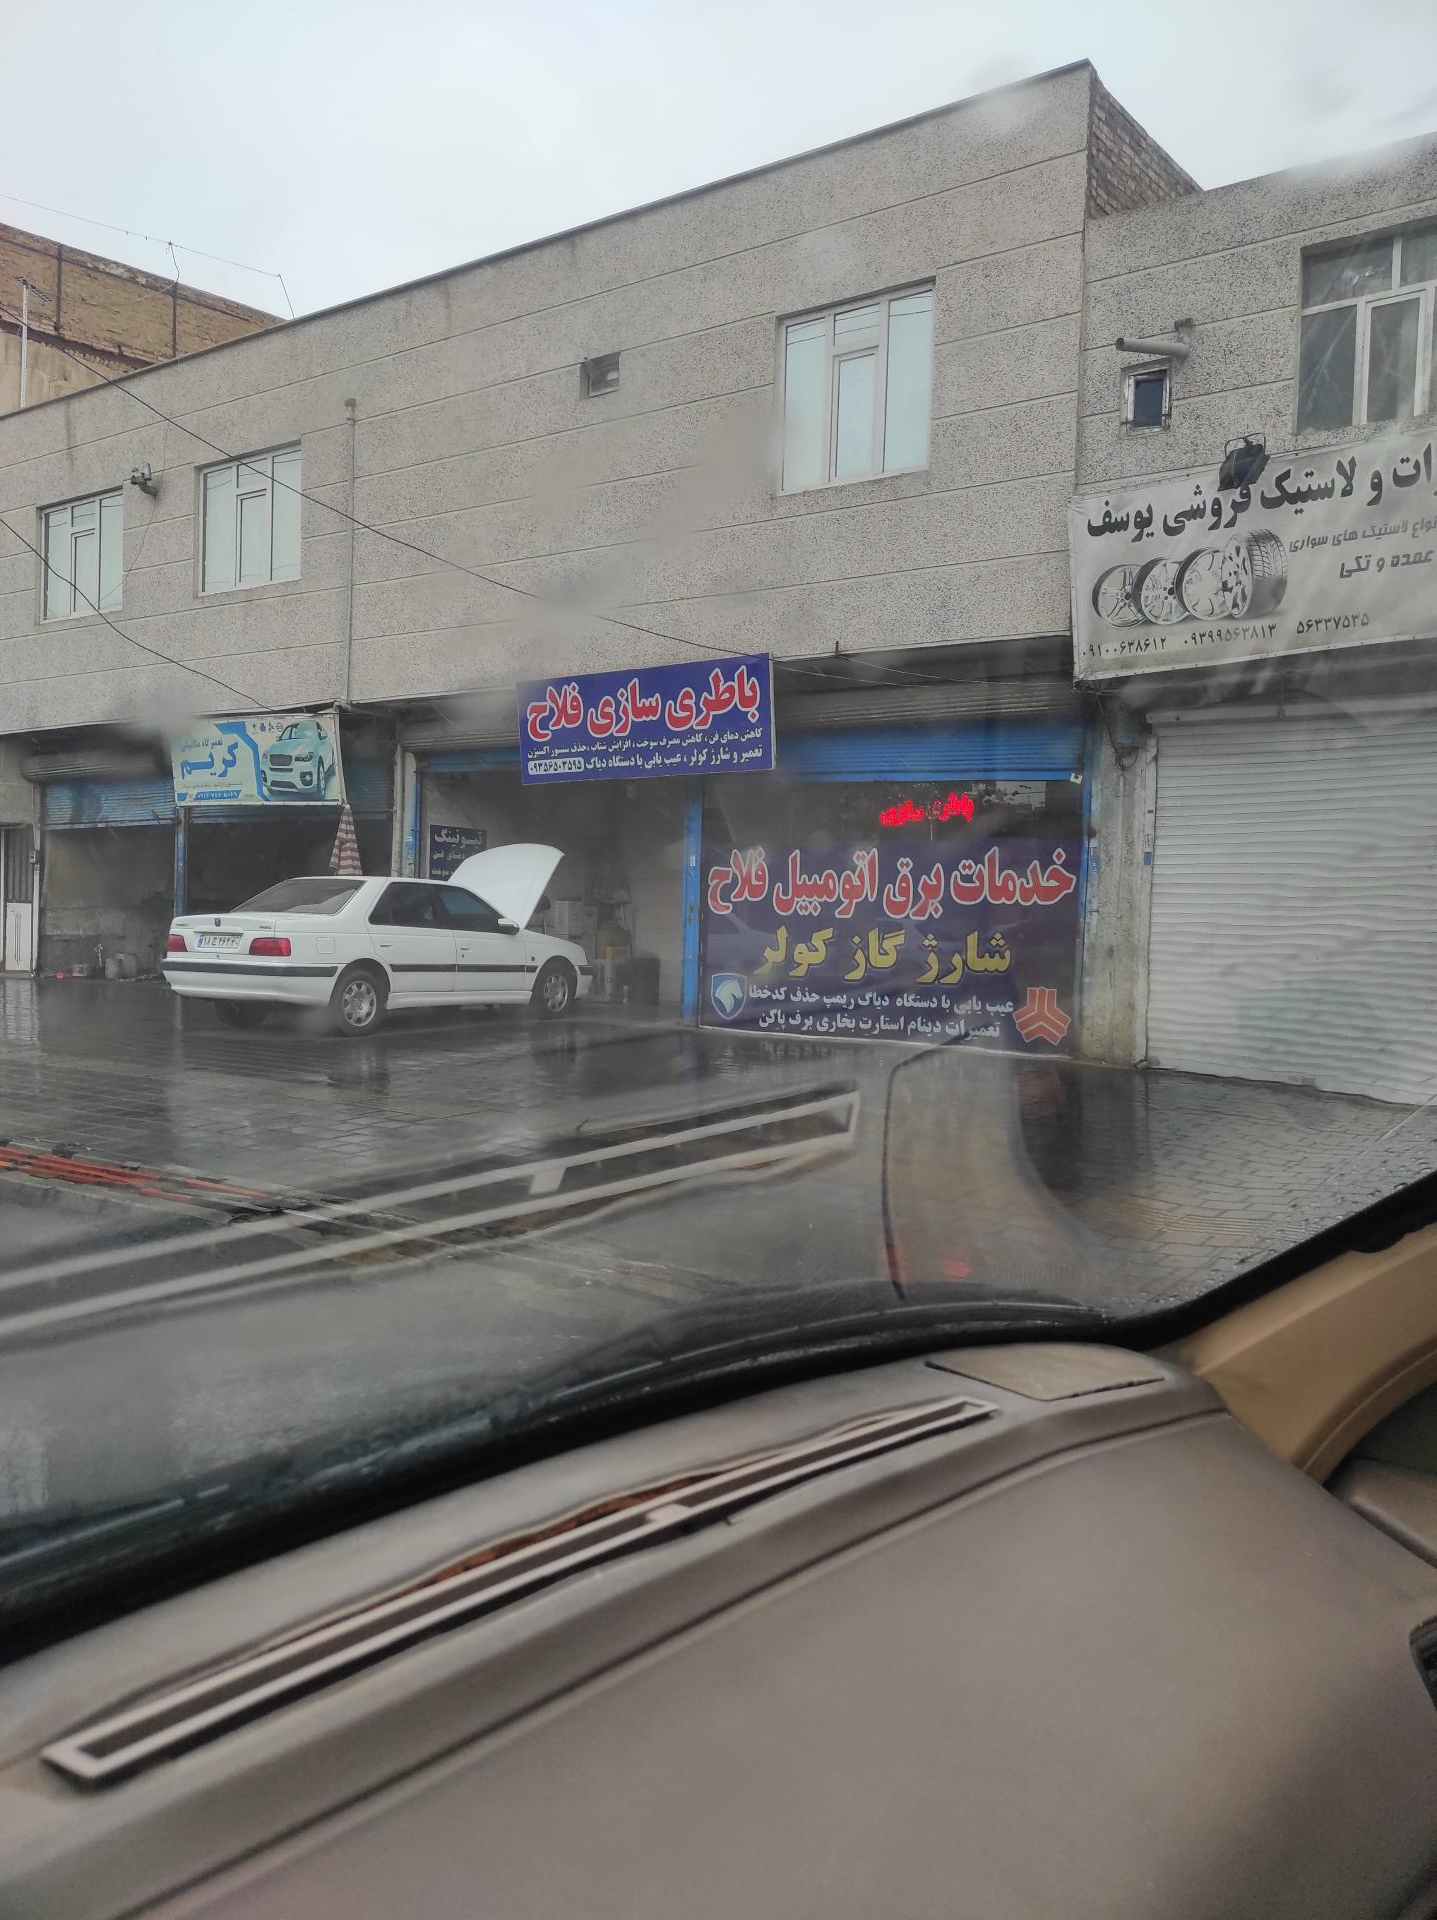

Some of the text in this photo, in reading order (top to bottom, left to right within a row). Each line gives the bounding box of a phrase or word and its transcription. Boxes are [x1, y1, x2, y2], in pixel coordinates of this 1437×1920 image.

[1087, 442, 1437, 543] ات و لاستیک فروشی یوسف
[1289, 515, 1437, 553] نواع لاستیک های سواری
[1340, 550, 1434, 579] عمده و تکی
[1296, 612, 1370, 635] ۵۶۳۳۷۵۳۵
[1184, 623, 1277, 646] ۰۹۳۹۹۵۶۳۸۱۳
[527, 664, 761, 742] باطری سازی فلاح
[659, 735, 681, 748] مصرف
[681, 732, 702, 747] کاهش
[720, 729, 739, 744] دمای
[740, 727, 763, 742] کاهش
[180, 741, 239, 780] کریم
[608, 755, 635, 767] دستگاه
[644, 751, 662, 769] یابی
[663, 752, 682, 766] عیب
[710, 746, 731, 765] شارژ
[732, 751, 738, 764] و
[740, 744, 763, 763] تعمیر
[708, 846, 1076, 920] خدمات برق اتومبیل فلاح
[753, 925, 1012, 985] شارژ گاز کولر
[789, 986, 820, 1003] حذف
[896, 992, 938, 1009] دستگاه
[941, 994, 951, 1013] با
[953, 995, 982, 1015] یابی
[985, 1000, 1014, 1017] عیب
[816, 1012, 856, 1033] بخاری
[907, 1015, 942, 1037] دینام
[945, 1018, 1001, 1041] تعمیرات
